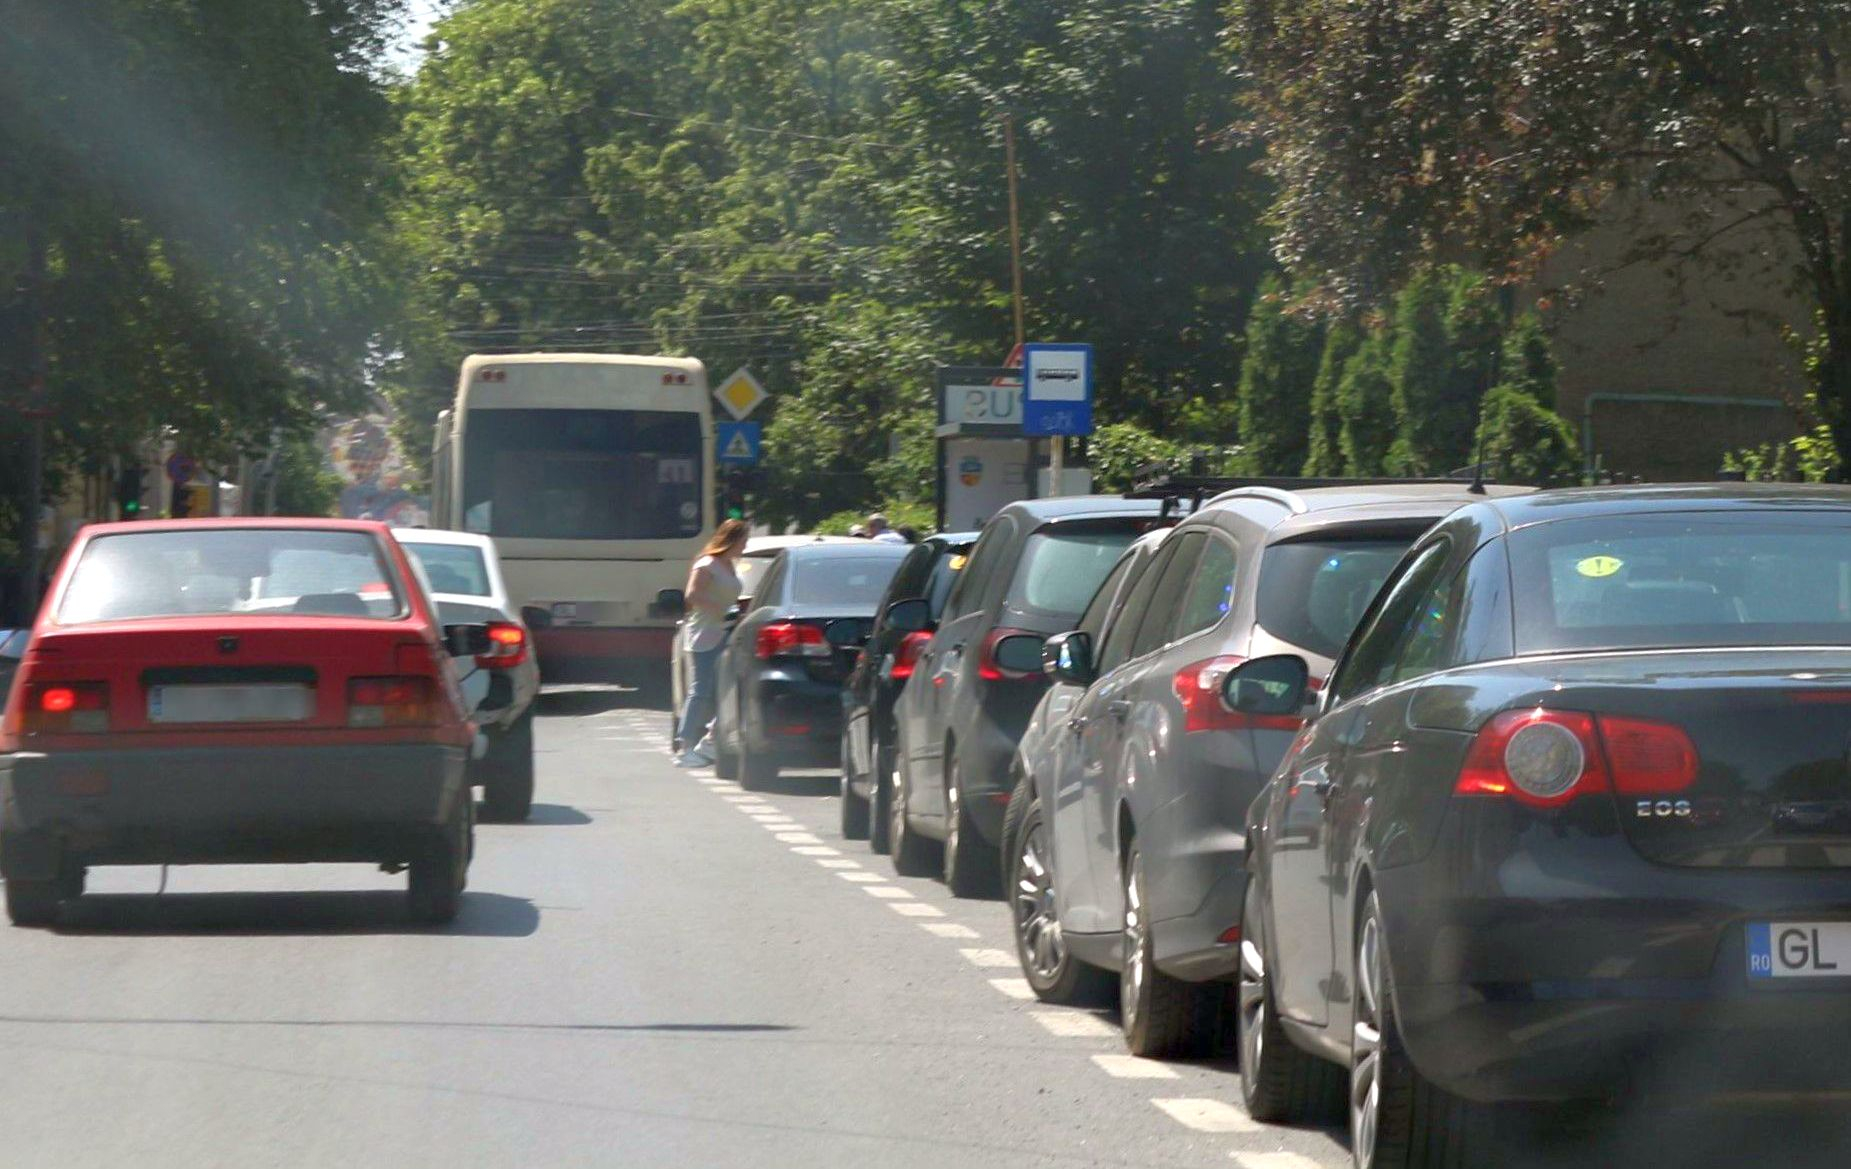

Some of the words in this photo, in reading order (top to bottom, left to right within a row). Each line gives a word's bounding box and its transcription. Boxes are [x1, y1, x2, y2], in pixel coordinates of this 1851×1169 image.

[1637, 801, 1691, 817] EOS
[1778, 928, 1837, 970] GL
[1751, 954, 1769, 971] RO
